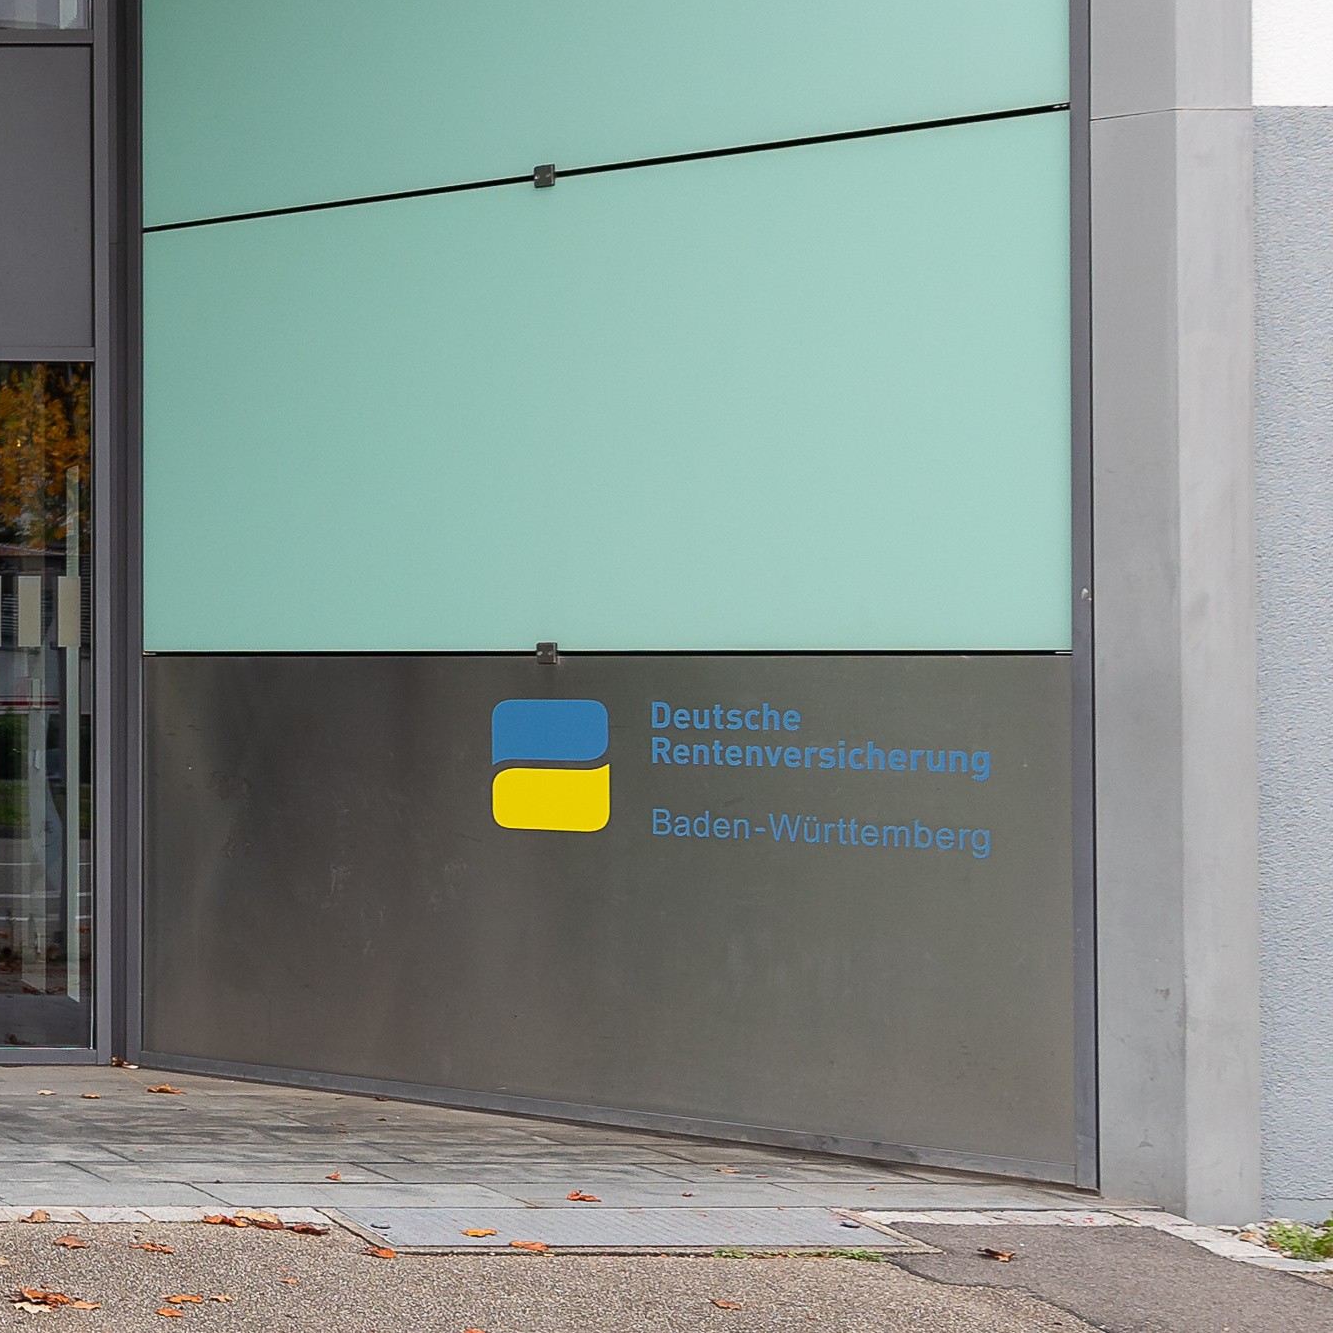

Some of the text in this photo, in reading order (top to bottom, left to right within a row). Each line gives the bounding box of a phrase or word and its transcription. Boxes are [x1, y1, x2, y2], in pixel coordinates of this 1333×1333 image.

[651, 701, 802, 732] Deutsche
[651, 736, 991, 782] Rentenversicherung
[651, 807, 991, 859] Baden-Württemberg
